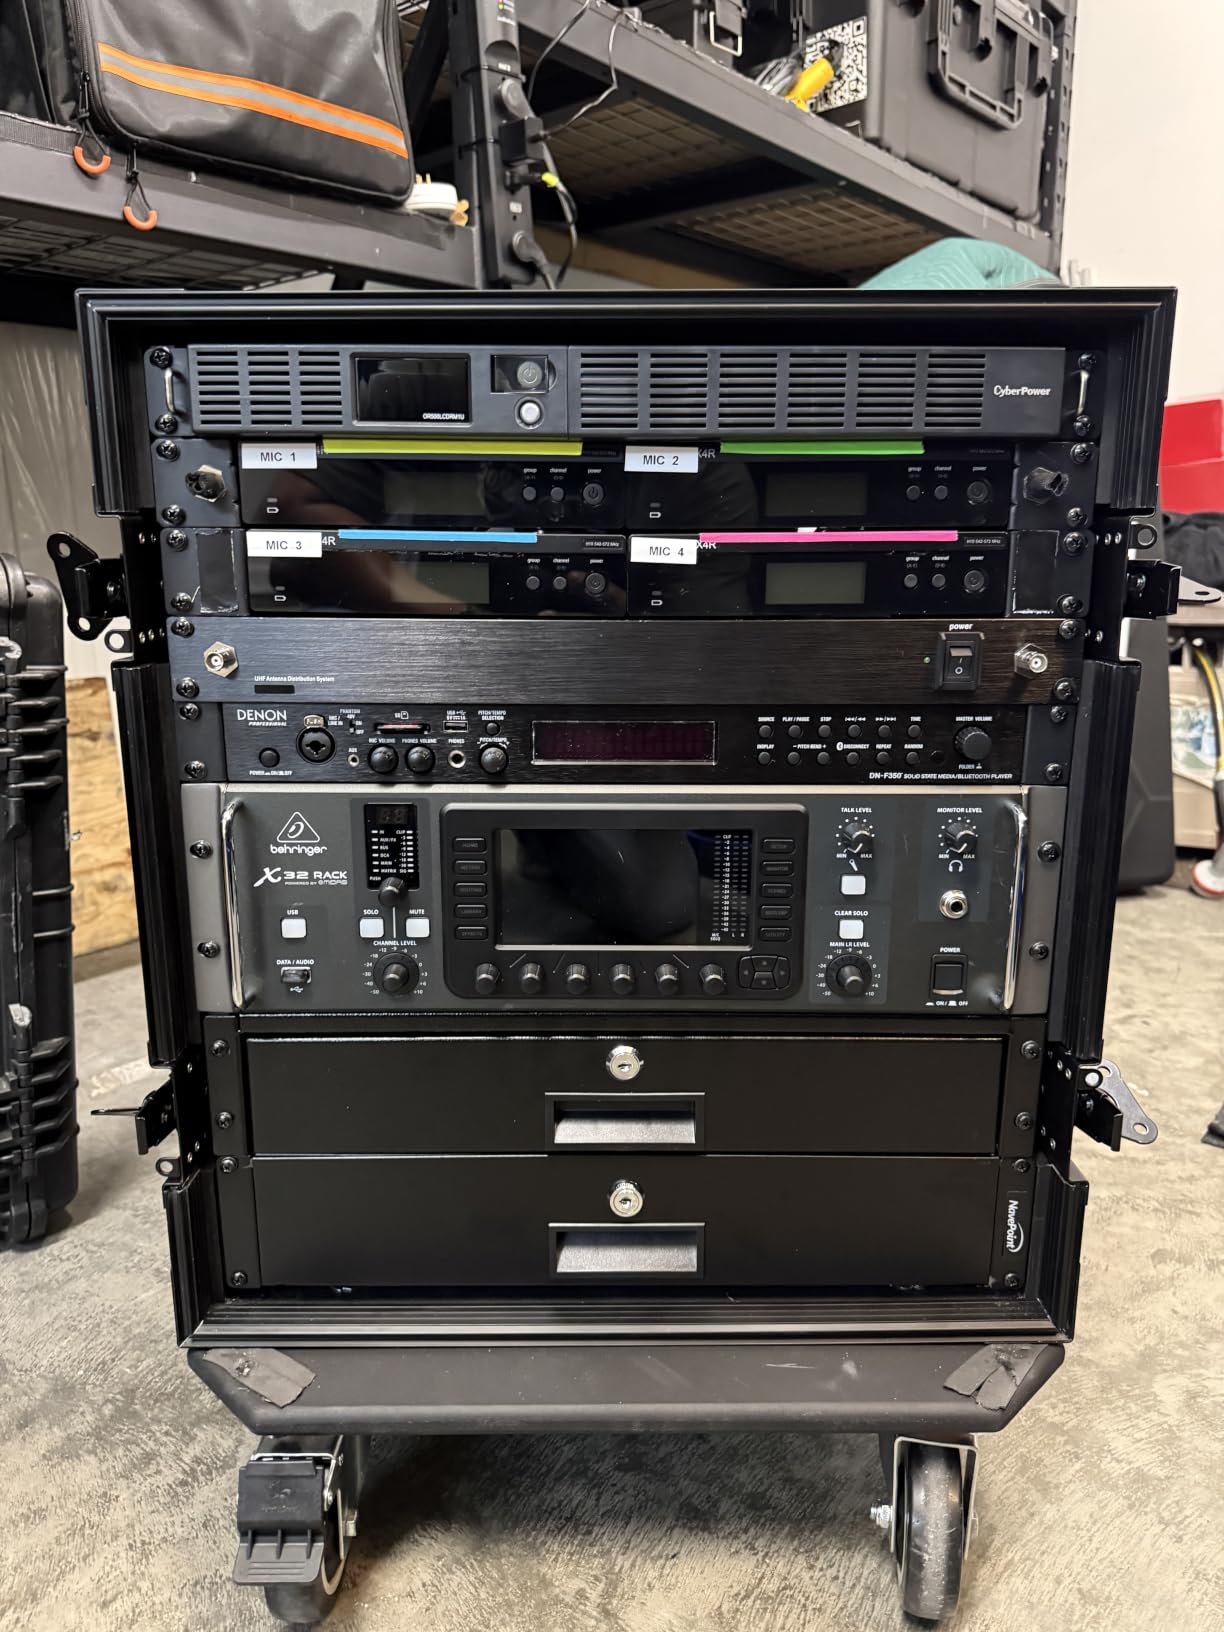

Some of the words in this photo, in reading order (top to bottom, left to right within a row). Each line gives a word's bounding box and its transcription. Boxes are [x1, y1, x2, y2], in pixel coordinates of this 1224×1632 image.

[993, 384, 1051, 398] CyberPower
[260, 452, 282, 462] MIC
[291, 452, 296, 462] 1
[643, 455, 665, 465] MIC
[672, 455, 679, 465] 2
[266, 540, 288, 550] MIC
[295, 541, 302, 550] 3
[649, 546, 671, 556] MIC
[677, 547, 685, 556] 4
[948, 623, 974, 631] power
[237, 709, 287, 721] DENON
[270, 844, 328, 856] behringer
[253, 867, 309, 887] X32
[313, 871, 348, 879] RACK
[1006, 1199, 1019, 1249] NavePoint
